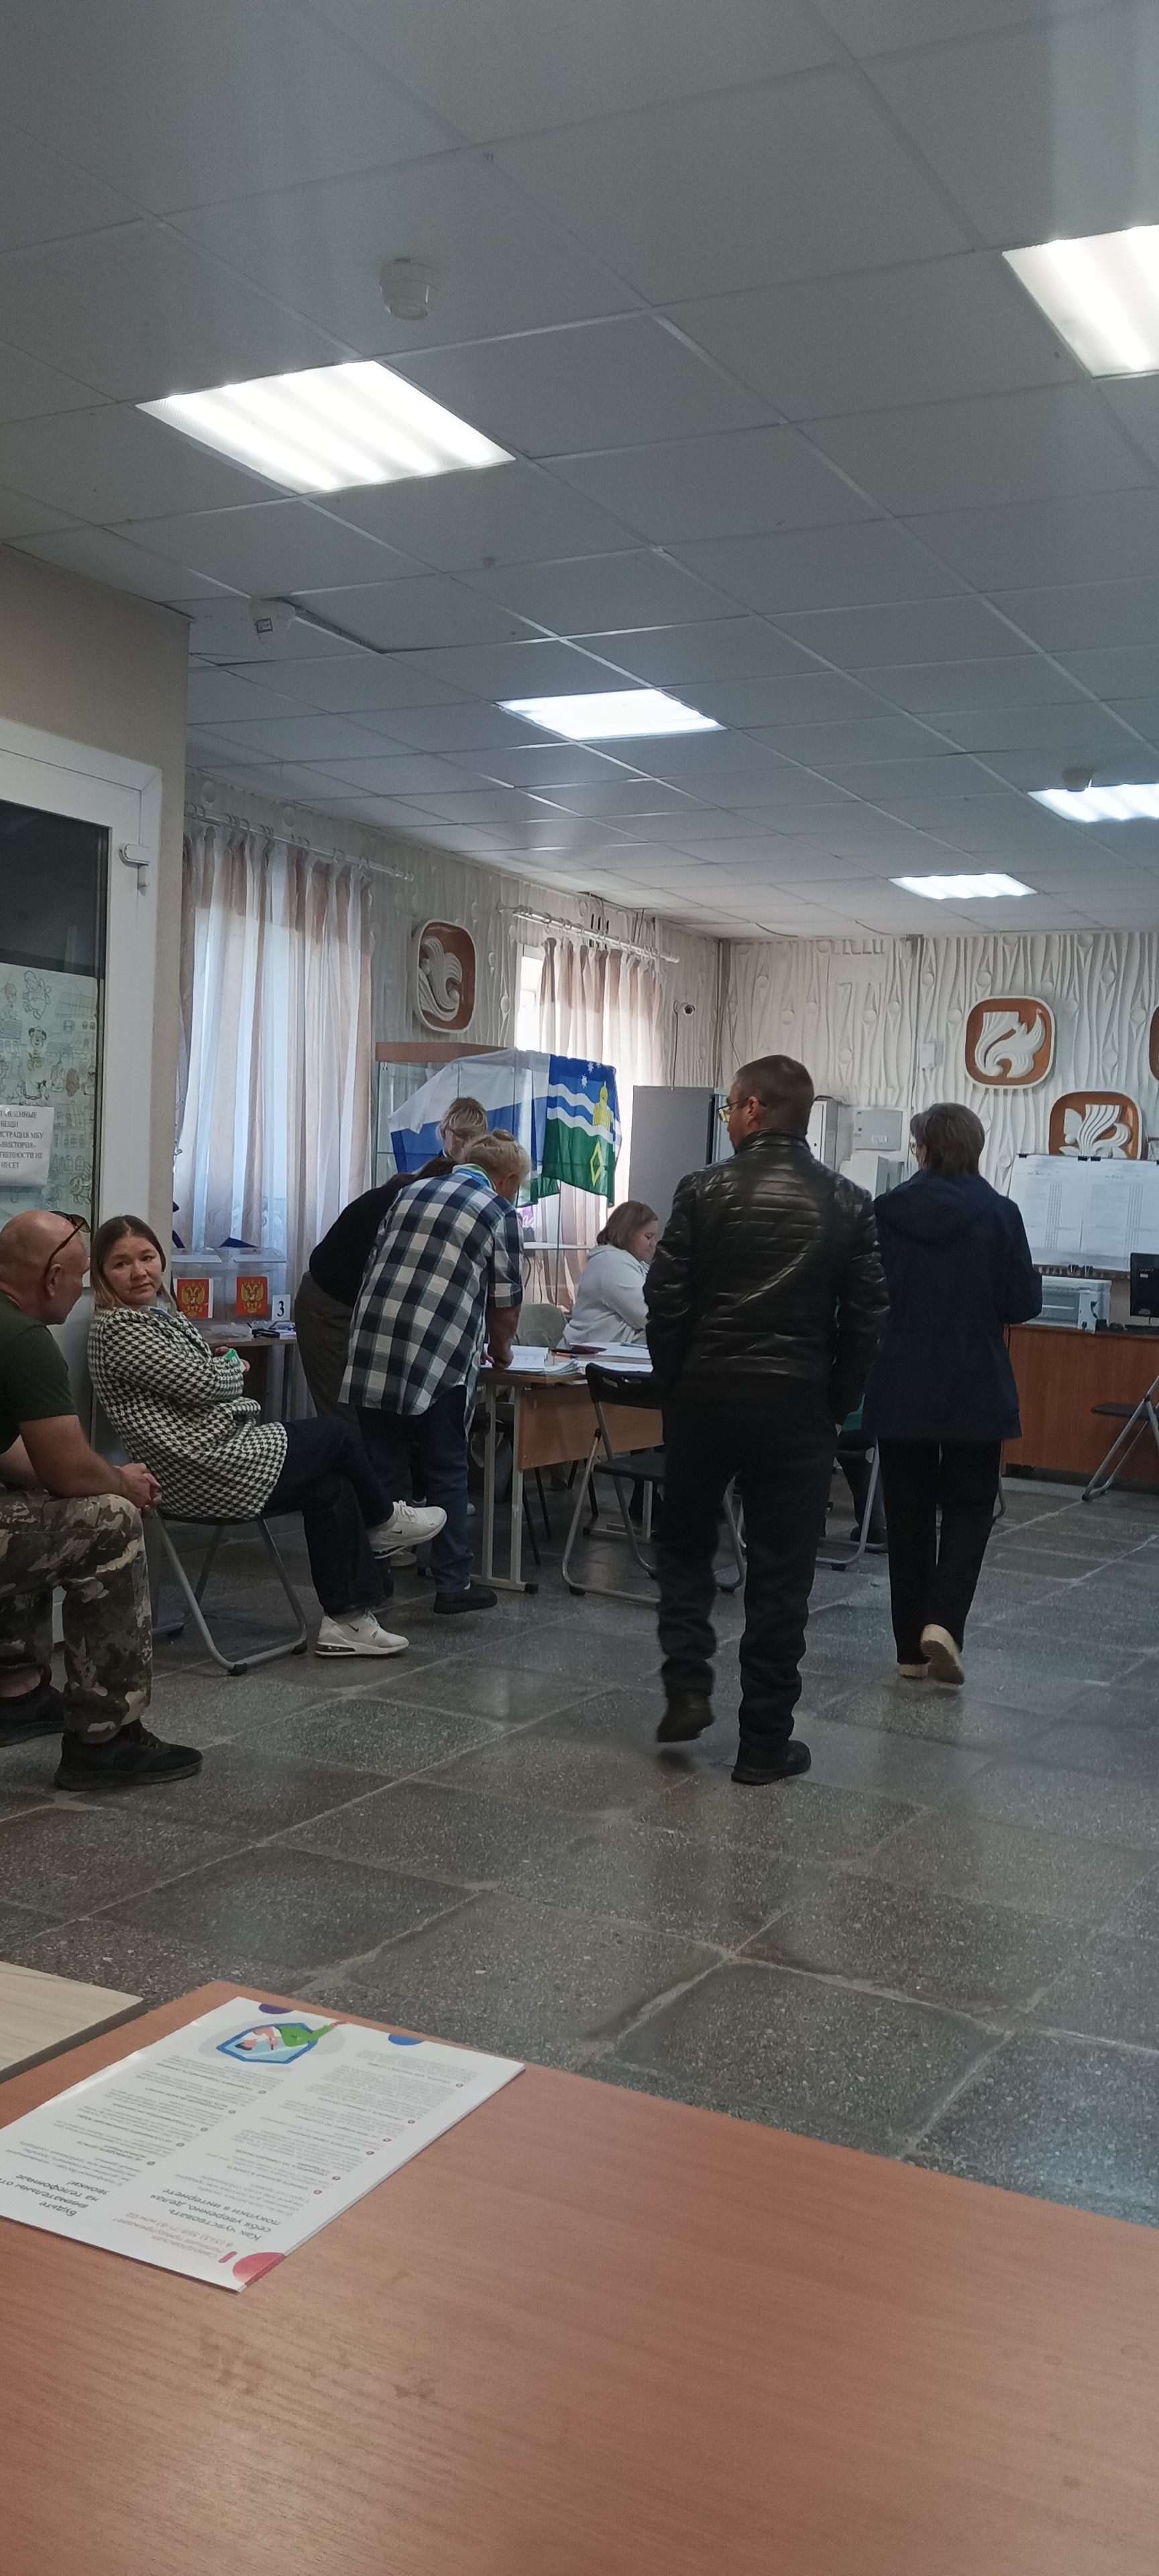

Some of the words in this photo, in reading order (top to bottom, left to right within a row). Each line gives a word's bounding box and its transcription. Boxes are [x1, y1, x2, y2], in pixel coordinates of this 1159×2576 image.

[0, 1131, 29, 1139] СТРАЦИЯ
[277, 1300, 284, 1317] 3
[15, 2174, 82, 2197] телефонные
[66, 2182, 109, 2194] звонки!
[14, 2184, 89, 2208] внимательны
[150, 2194, 186, 2206] делая
[162, 2188, 221, 2208] интернете
[39, 2202, 77, 2216] Будьте
[188, 2204, 242, 2224] уверенно,
[231, 2208, 280, 2225] покупки
[169, 2209, 235, 2233] чувствовать
[243, 2222, 271, 2232] себя
[241, 2230, 261, 2241] Как
